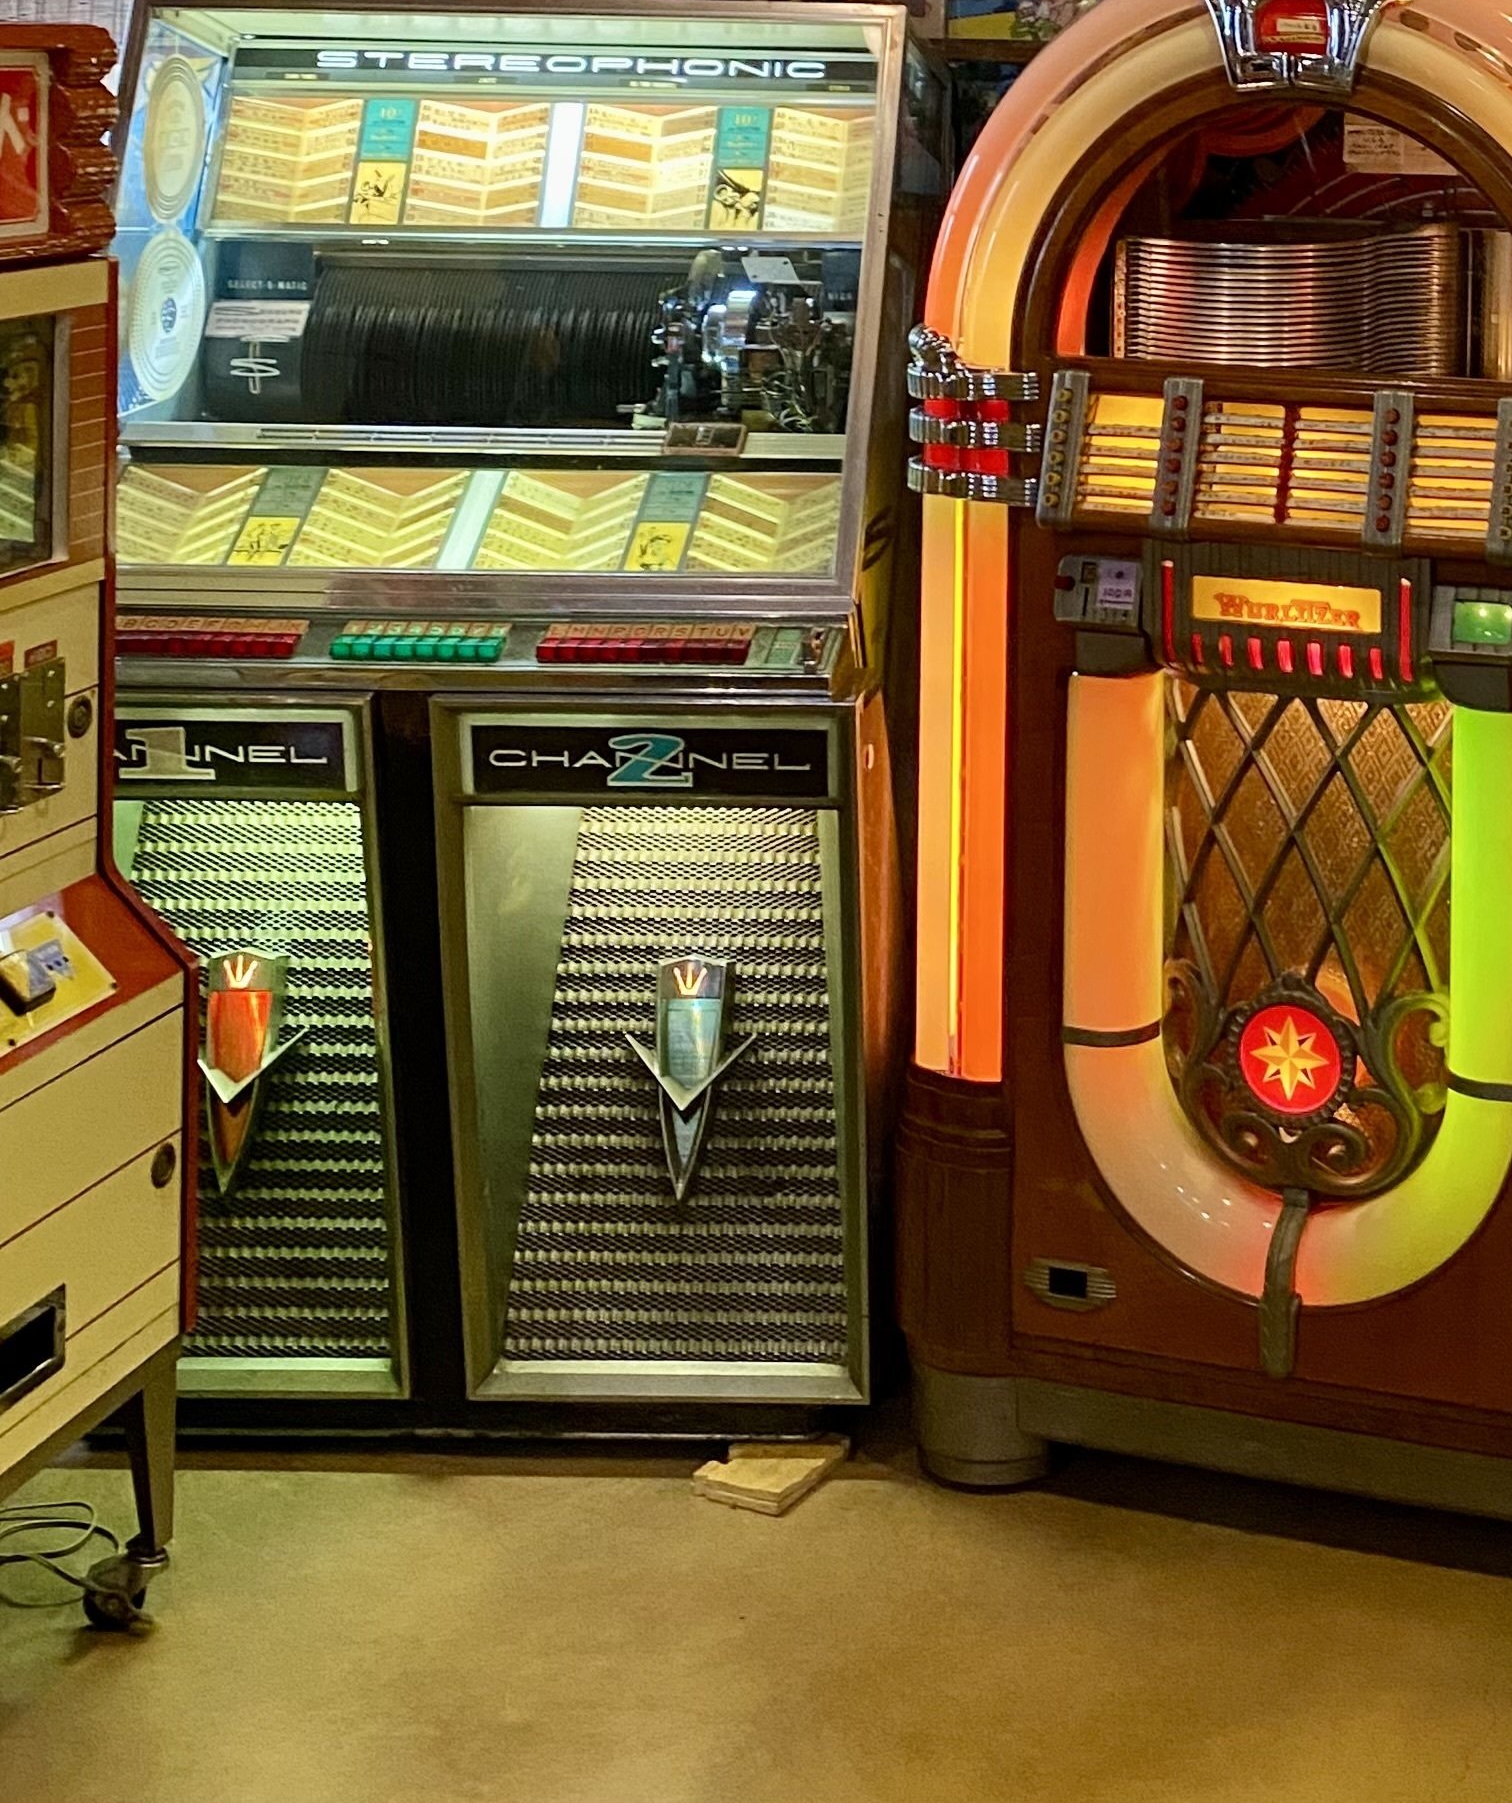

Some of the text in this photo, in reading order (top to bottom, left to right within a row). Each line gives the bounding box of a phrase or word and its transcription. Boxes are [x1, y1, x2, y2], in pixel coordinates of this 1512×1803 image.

[316, 50, 826, 79] STEREOPHONIC
[119, 727, 217, 779] 1
[489, 749, 811, 771] CHANNEL
[606, 733, 692, 788] 2
